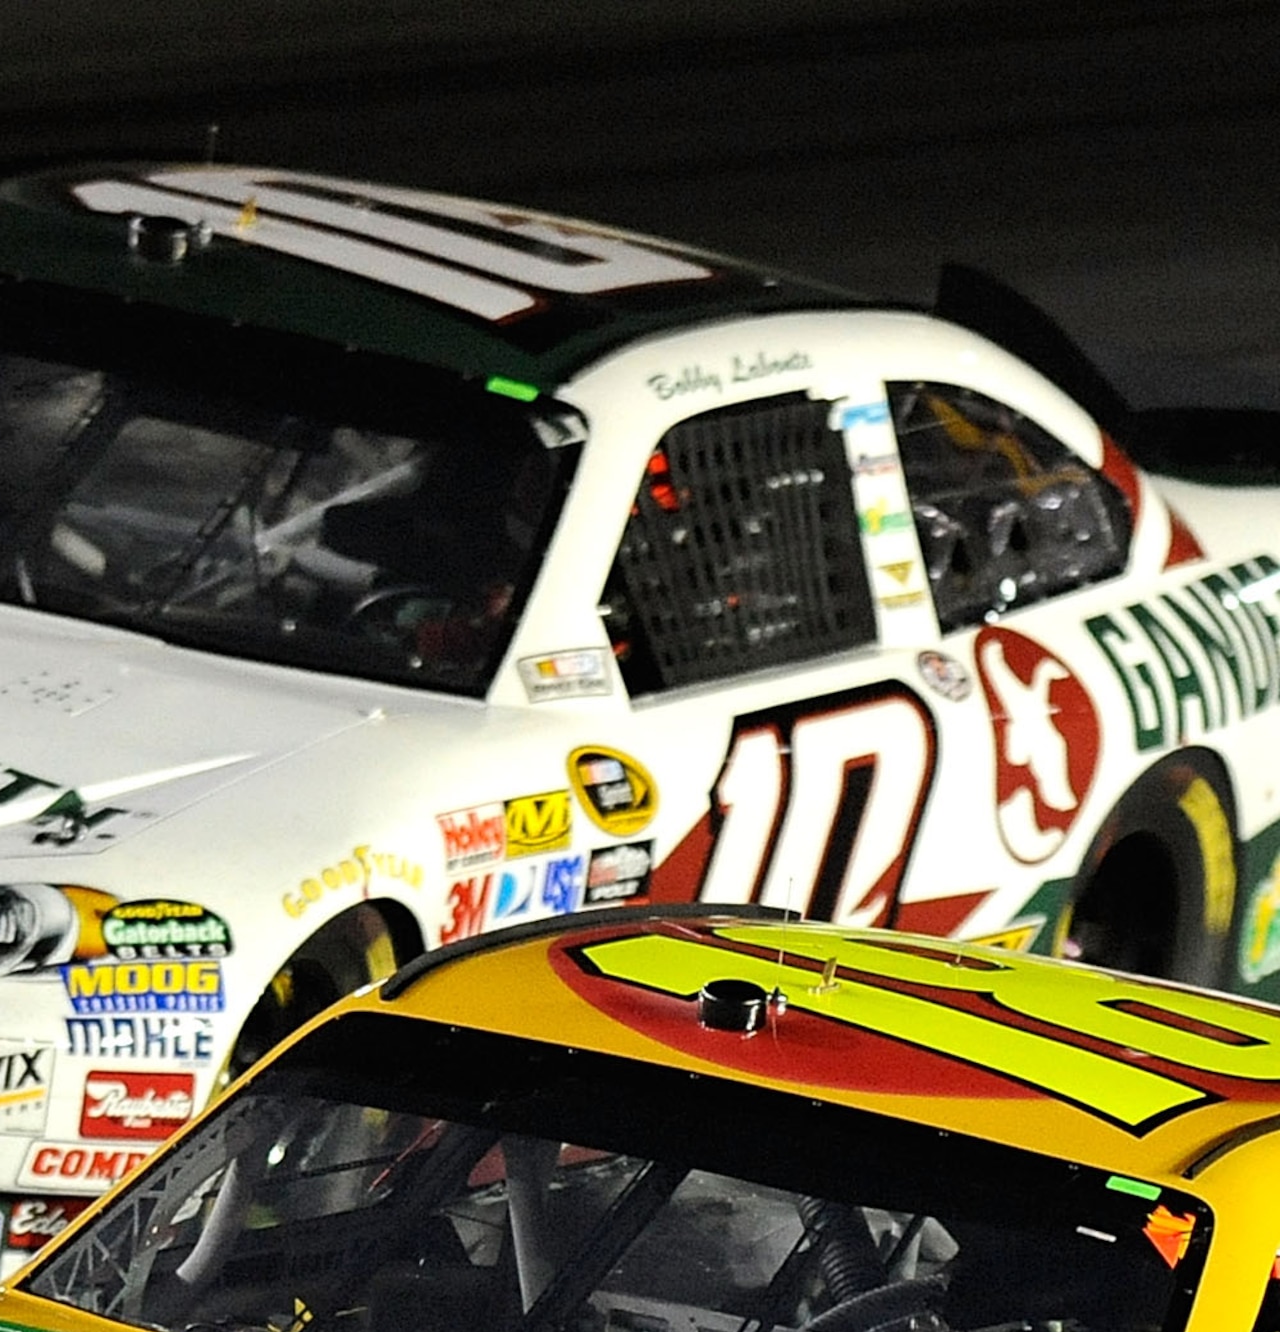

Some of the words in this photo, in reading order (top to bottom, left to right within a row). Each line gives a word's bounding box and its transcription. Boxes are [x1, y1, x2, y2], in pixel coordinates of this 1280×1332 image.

[699, 679, 939, 928] 10
[439, 870, 493, 944] 3M
[104, 916, 227, 946] Gatorback
[116, 943, 227, 961] BELTS
[70, 961, 220, 997] MOOG
[65, 1018, 214, 1060] MAHLE
